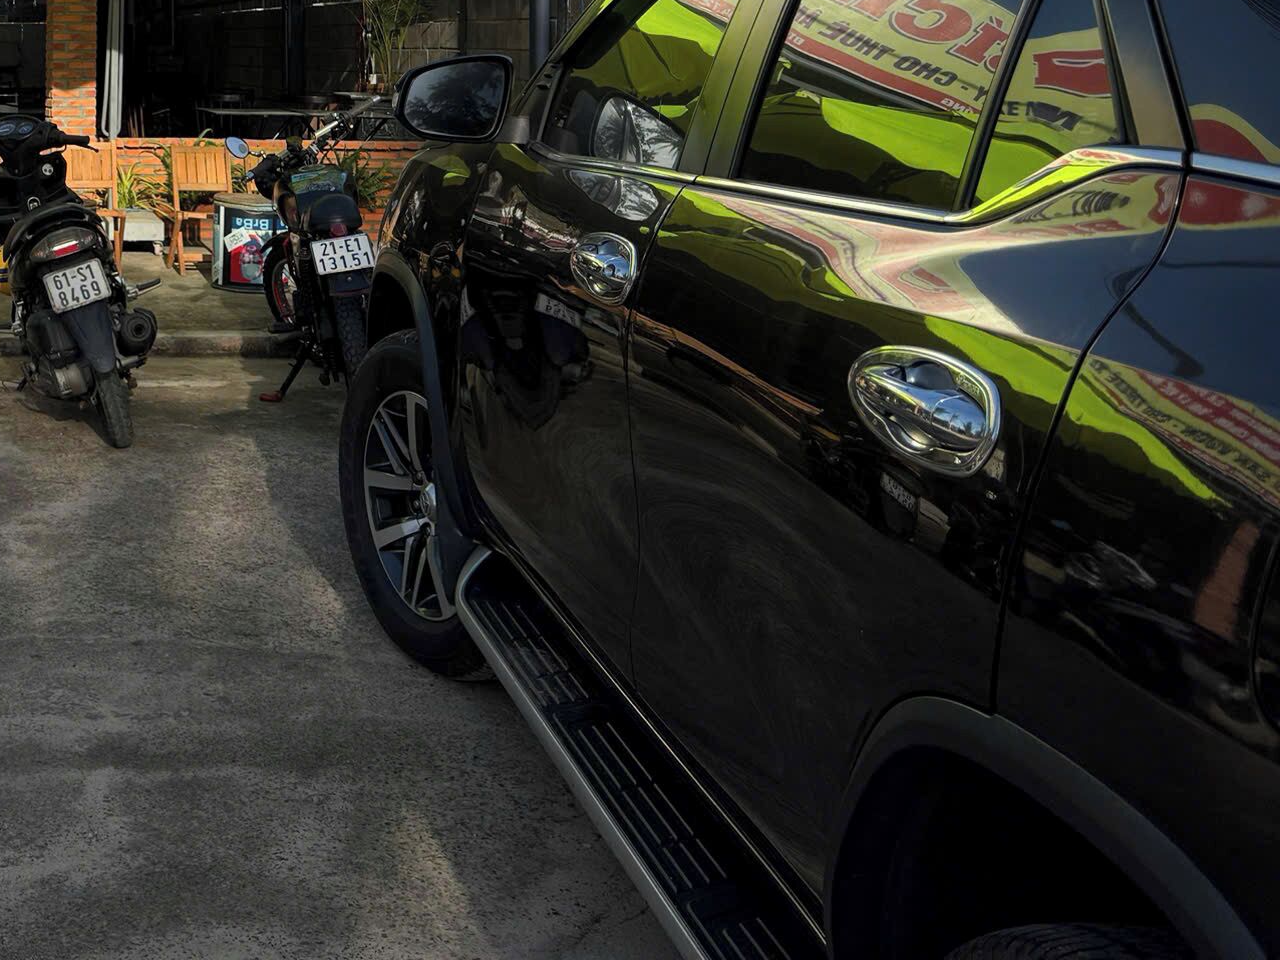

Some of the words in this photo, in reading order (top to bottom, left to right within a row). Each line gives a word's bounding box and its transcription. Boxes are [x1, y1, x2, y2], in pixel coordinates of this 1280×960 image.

[235, 217, 269, 231] BrBa
[320, 238, 361, 257] 21-E1
[319, 251, 371, 272] 131.51
[52, 264, 95, 291] 61-S1
[58, 281, 102, 307] 8469
